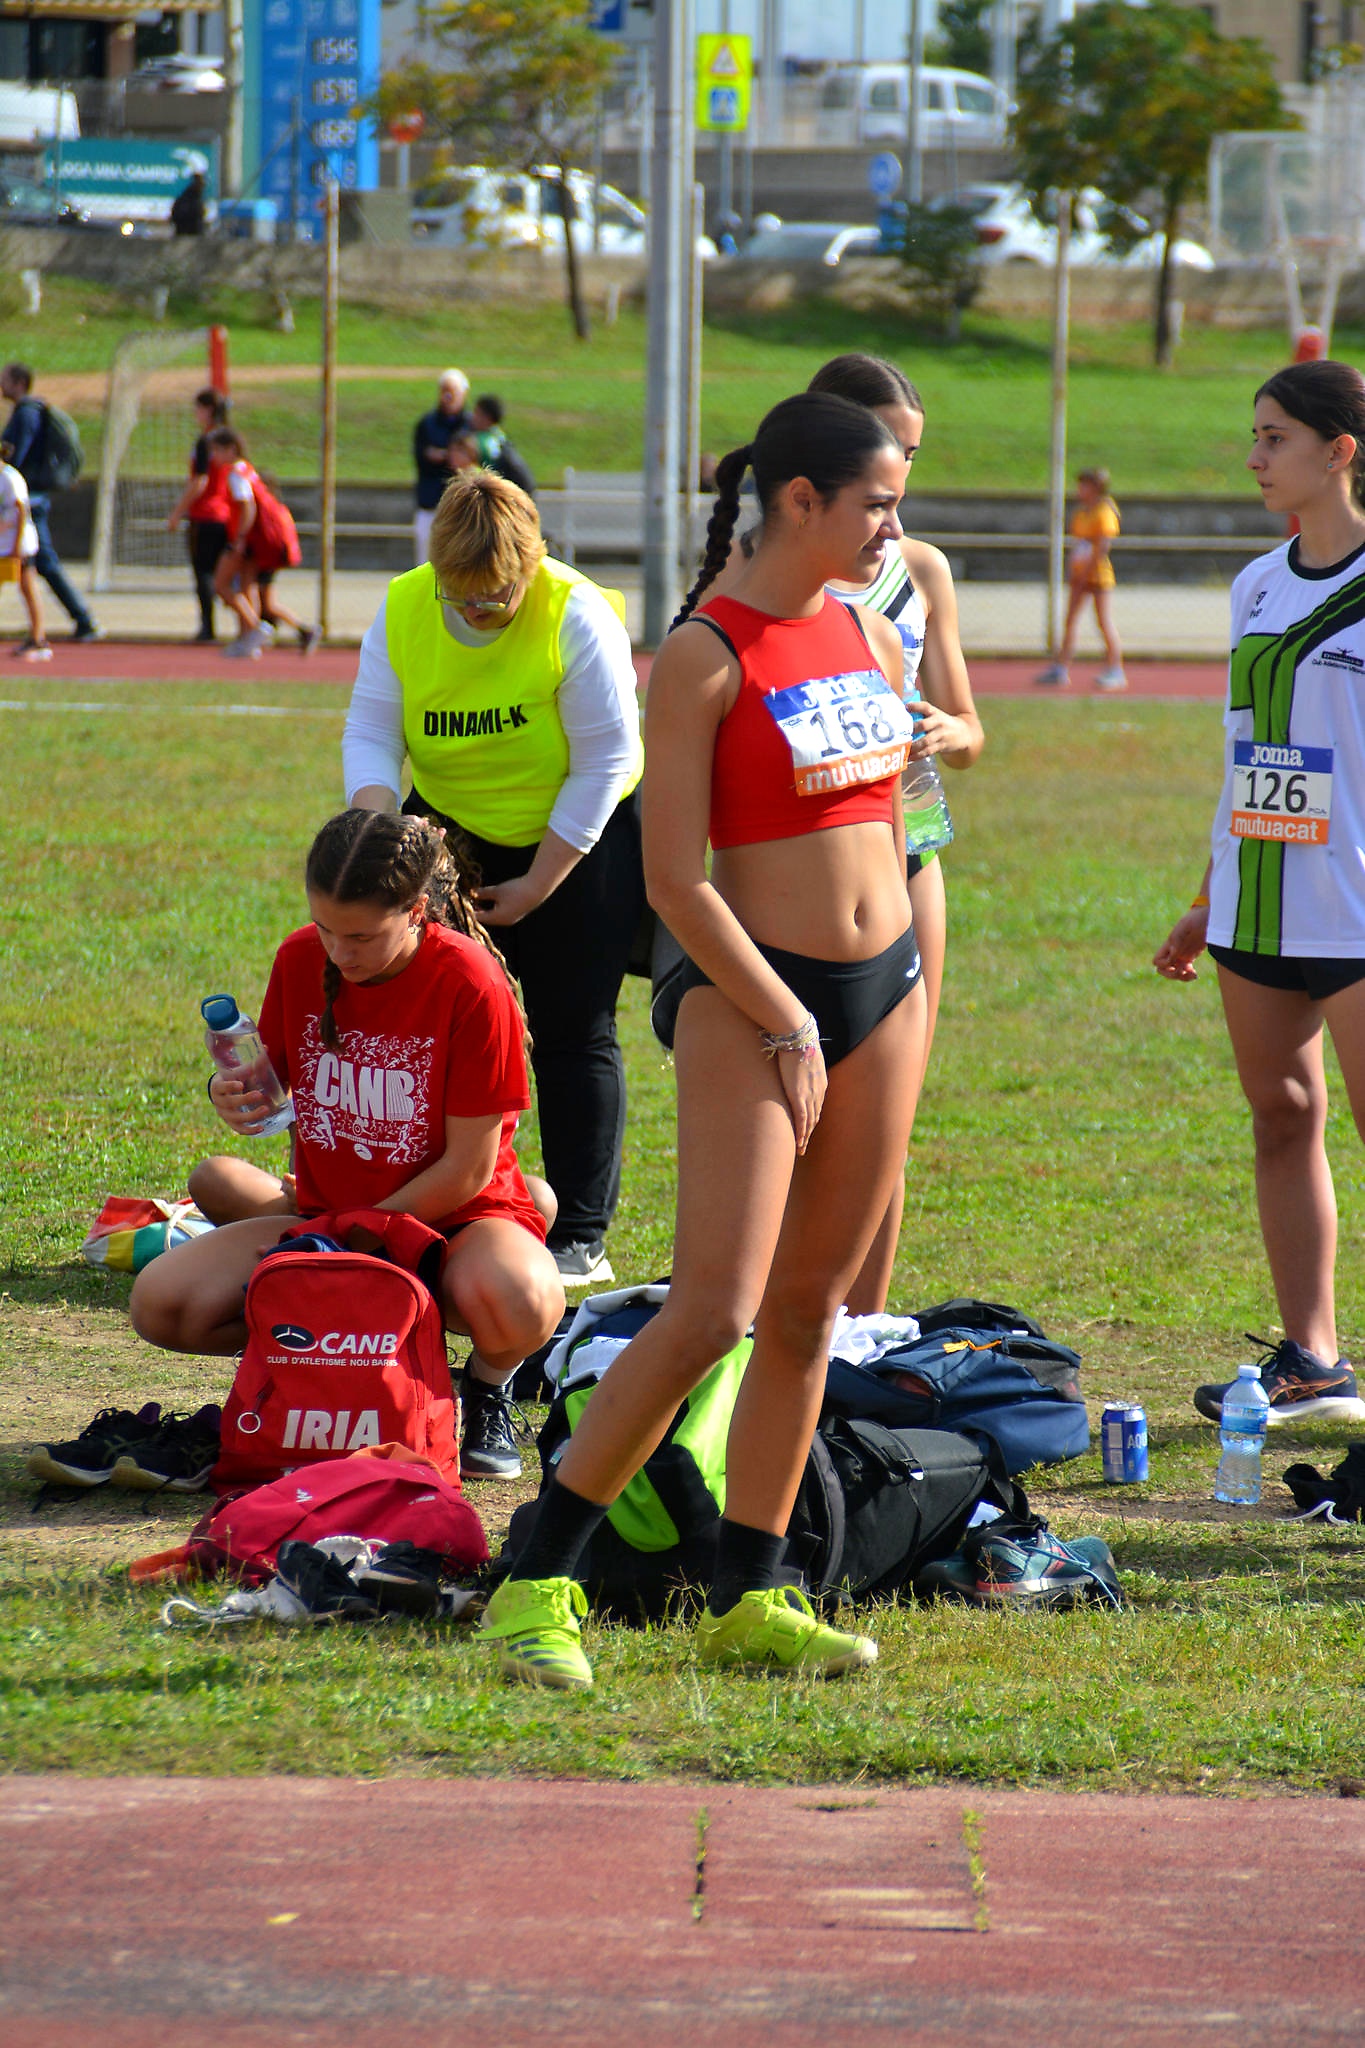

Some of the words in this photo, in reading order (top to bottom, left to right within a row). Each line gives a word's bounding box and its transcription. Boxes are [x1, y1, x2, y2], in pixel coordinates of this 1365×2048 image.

[424, 704, 528, 737] DINAMI-K
[810, 700, 895, 757] 168
[806, 745, 907, 791] mutuacat
[1245, 769, 1308, 814] 126
[1234, 816, 1319, 841] mutuacat
[314, 1052, 415, 1122] CANB
[266, 1356, 288, 1364] CLUB
[291, 1356, 347, 1366] D'ATLETISME
[350, 1359, 370, 1367] NOU
[321, 1332, 398, 1354] CANB
[282, 1410, 380, 1450] IRIA
